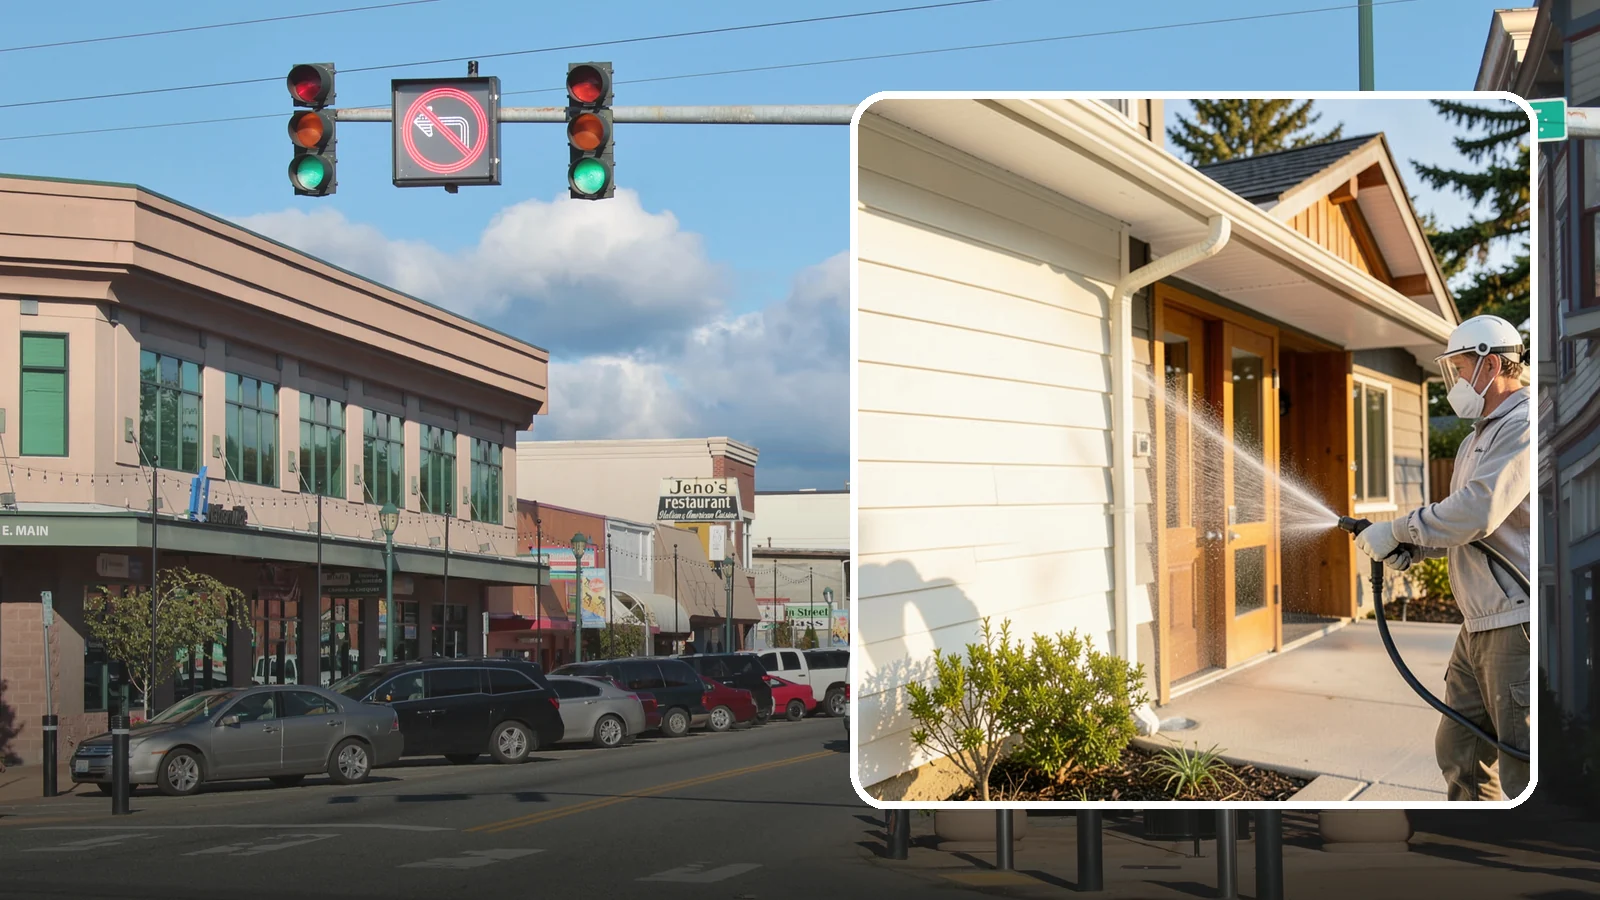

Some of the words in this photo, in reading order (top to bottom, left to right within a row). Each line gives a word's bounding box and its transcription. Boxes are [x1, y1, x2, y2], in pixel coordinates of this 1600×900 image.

[670, 480, 728, 494] Jeno's
[665, 496, 731, 509] restaurant
[659, 510, 681, 519] Italian
[686, 510, 714, 519] American
[715, 509, 737, 519] Cuisine
[2, 525, 13, 536] E.
[15, 525, 49, 536] MAIN
[797, 607, 829, 616] Street
[791, 619, 823, 627] lass
